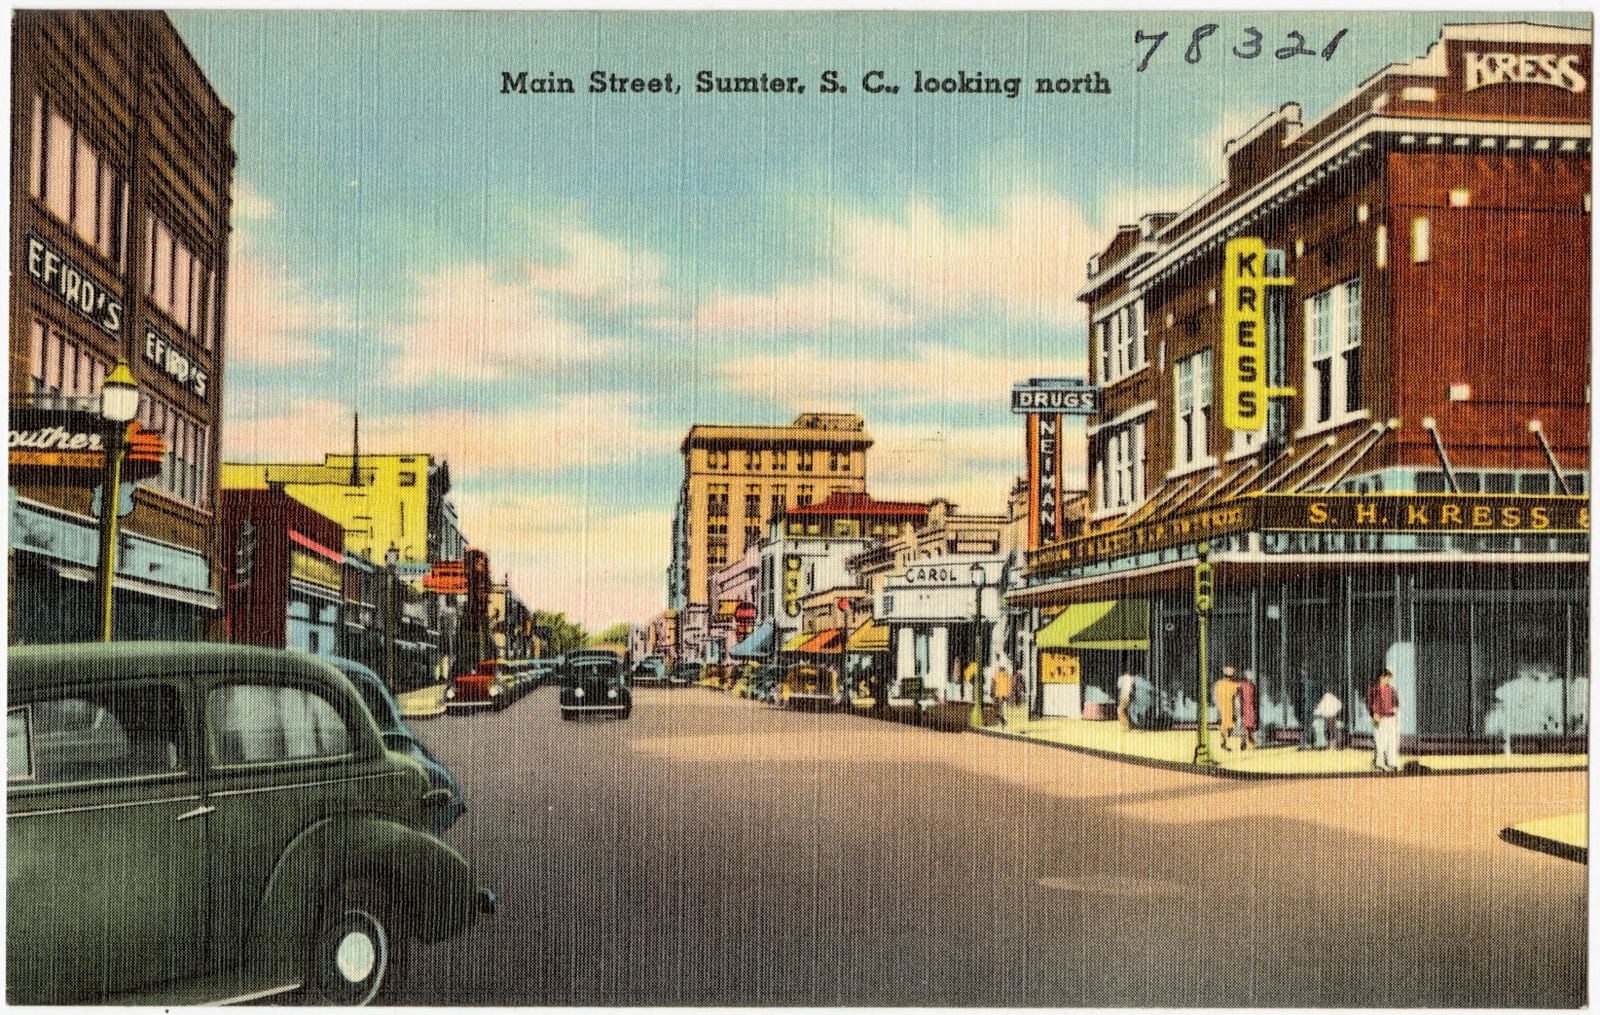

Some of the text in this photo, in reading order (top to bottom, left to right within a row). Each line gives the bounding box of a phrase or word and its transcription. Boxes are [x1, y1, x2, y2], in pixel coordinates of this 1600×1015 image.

[1464, 50, 1587, 94] KRESS
[27, 237, 123, 332] EFIRD'S
[1237, 251, 1258, 419] KRESS
[1019, 391, 1095, 408] DRUGS
[1308, 502, 1338, 524] S.
[1356, 503, 1388, 524] H.
[1407, 504, 1551, 529] KRESS
[905, 567, 958, 583] CAROL
